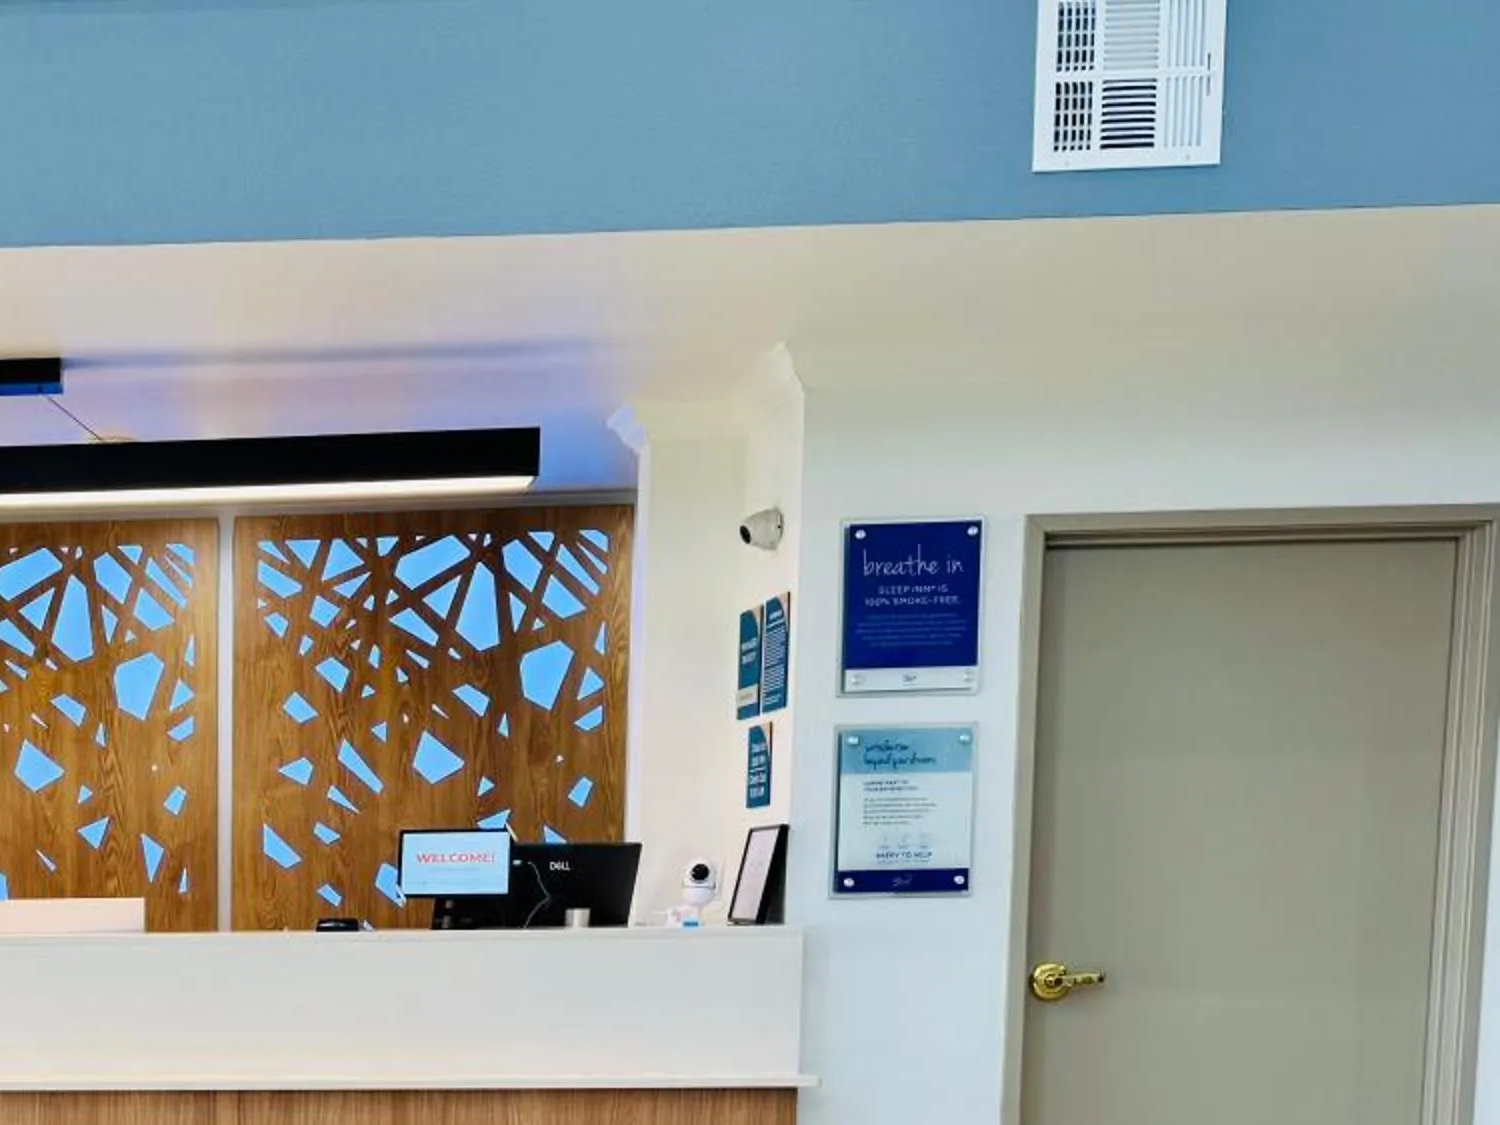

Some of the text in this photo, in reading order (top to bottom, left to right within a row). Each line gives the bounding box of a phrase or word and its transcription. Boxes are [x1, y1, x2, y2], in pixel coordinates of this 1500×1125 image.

[863, 543, 965, 576] breathe in
[877, 585, 910, 595] SLEEP
[864, 597, 891, 607] 100%
[417, 852, 495, 864] WELCOME!
[550, 861, 571, 871] DELL
